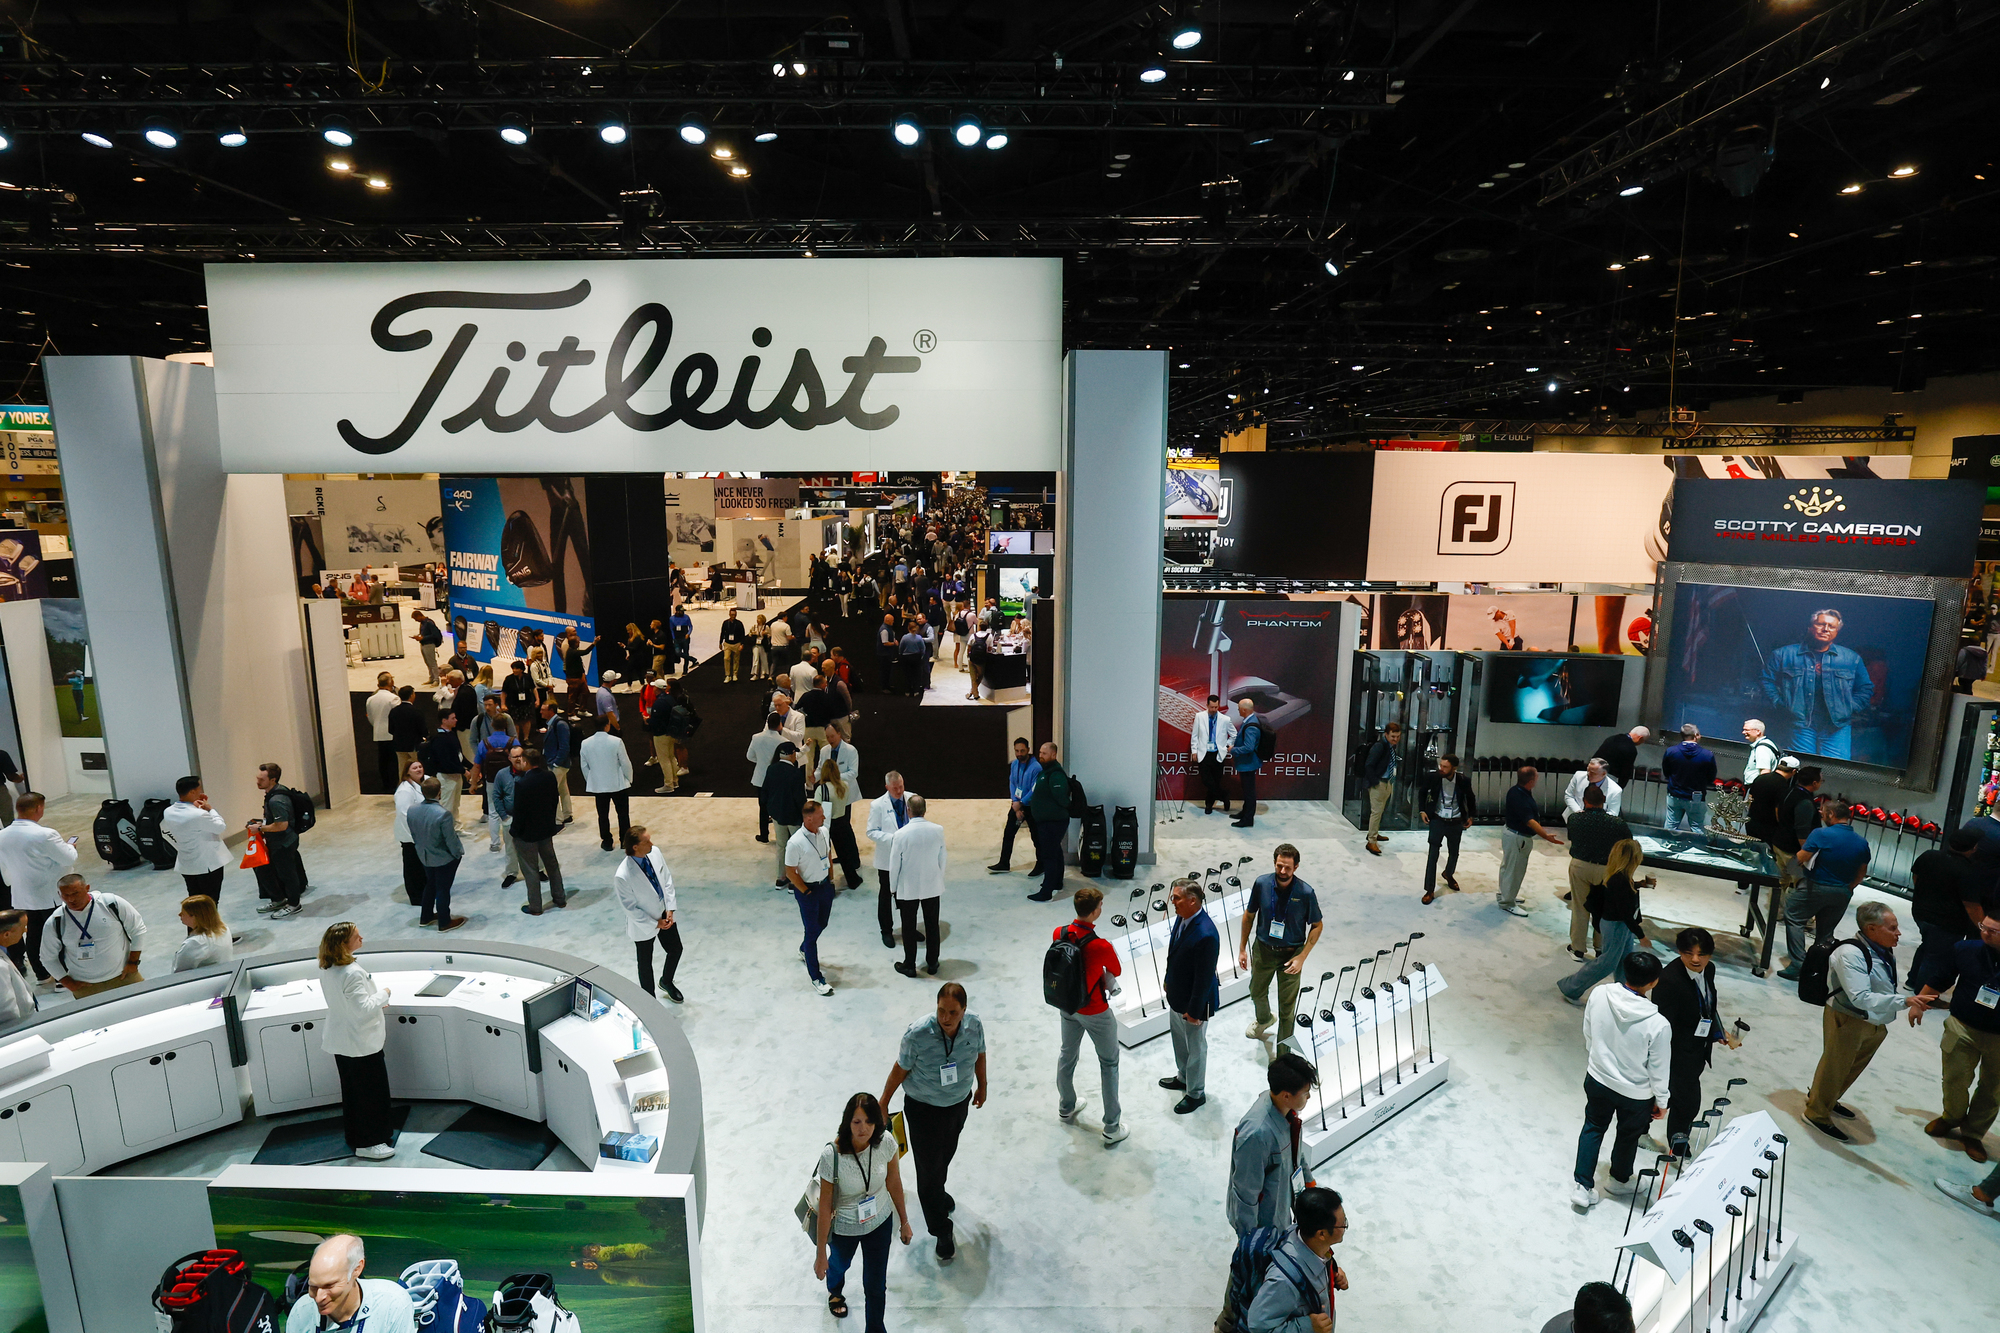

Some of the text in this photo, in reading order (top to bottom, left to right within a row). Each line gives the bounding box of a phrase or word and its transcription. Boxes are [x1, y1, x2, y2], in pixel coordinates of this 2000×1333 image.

[736, 487, 764, 497] NEVER
[315, 487, 325, 516] RICKIE
[721, 499, 796, 509] LOOKED SO FRESH
[1451, 494, 1502, 543] FJ
[1714, 519, 1922, 537] SCOTTY CAMERON
[1722, 532, 1908, 546] FINE MILLED PUTTERS
[450, 551, 499, 572] FAIRWAY
[451, 570, 500, 592] MAGNET.
[1274, 766, 1320, 775] FEEL.
